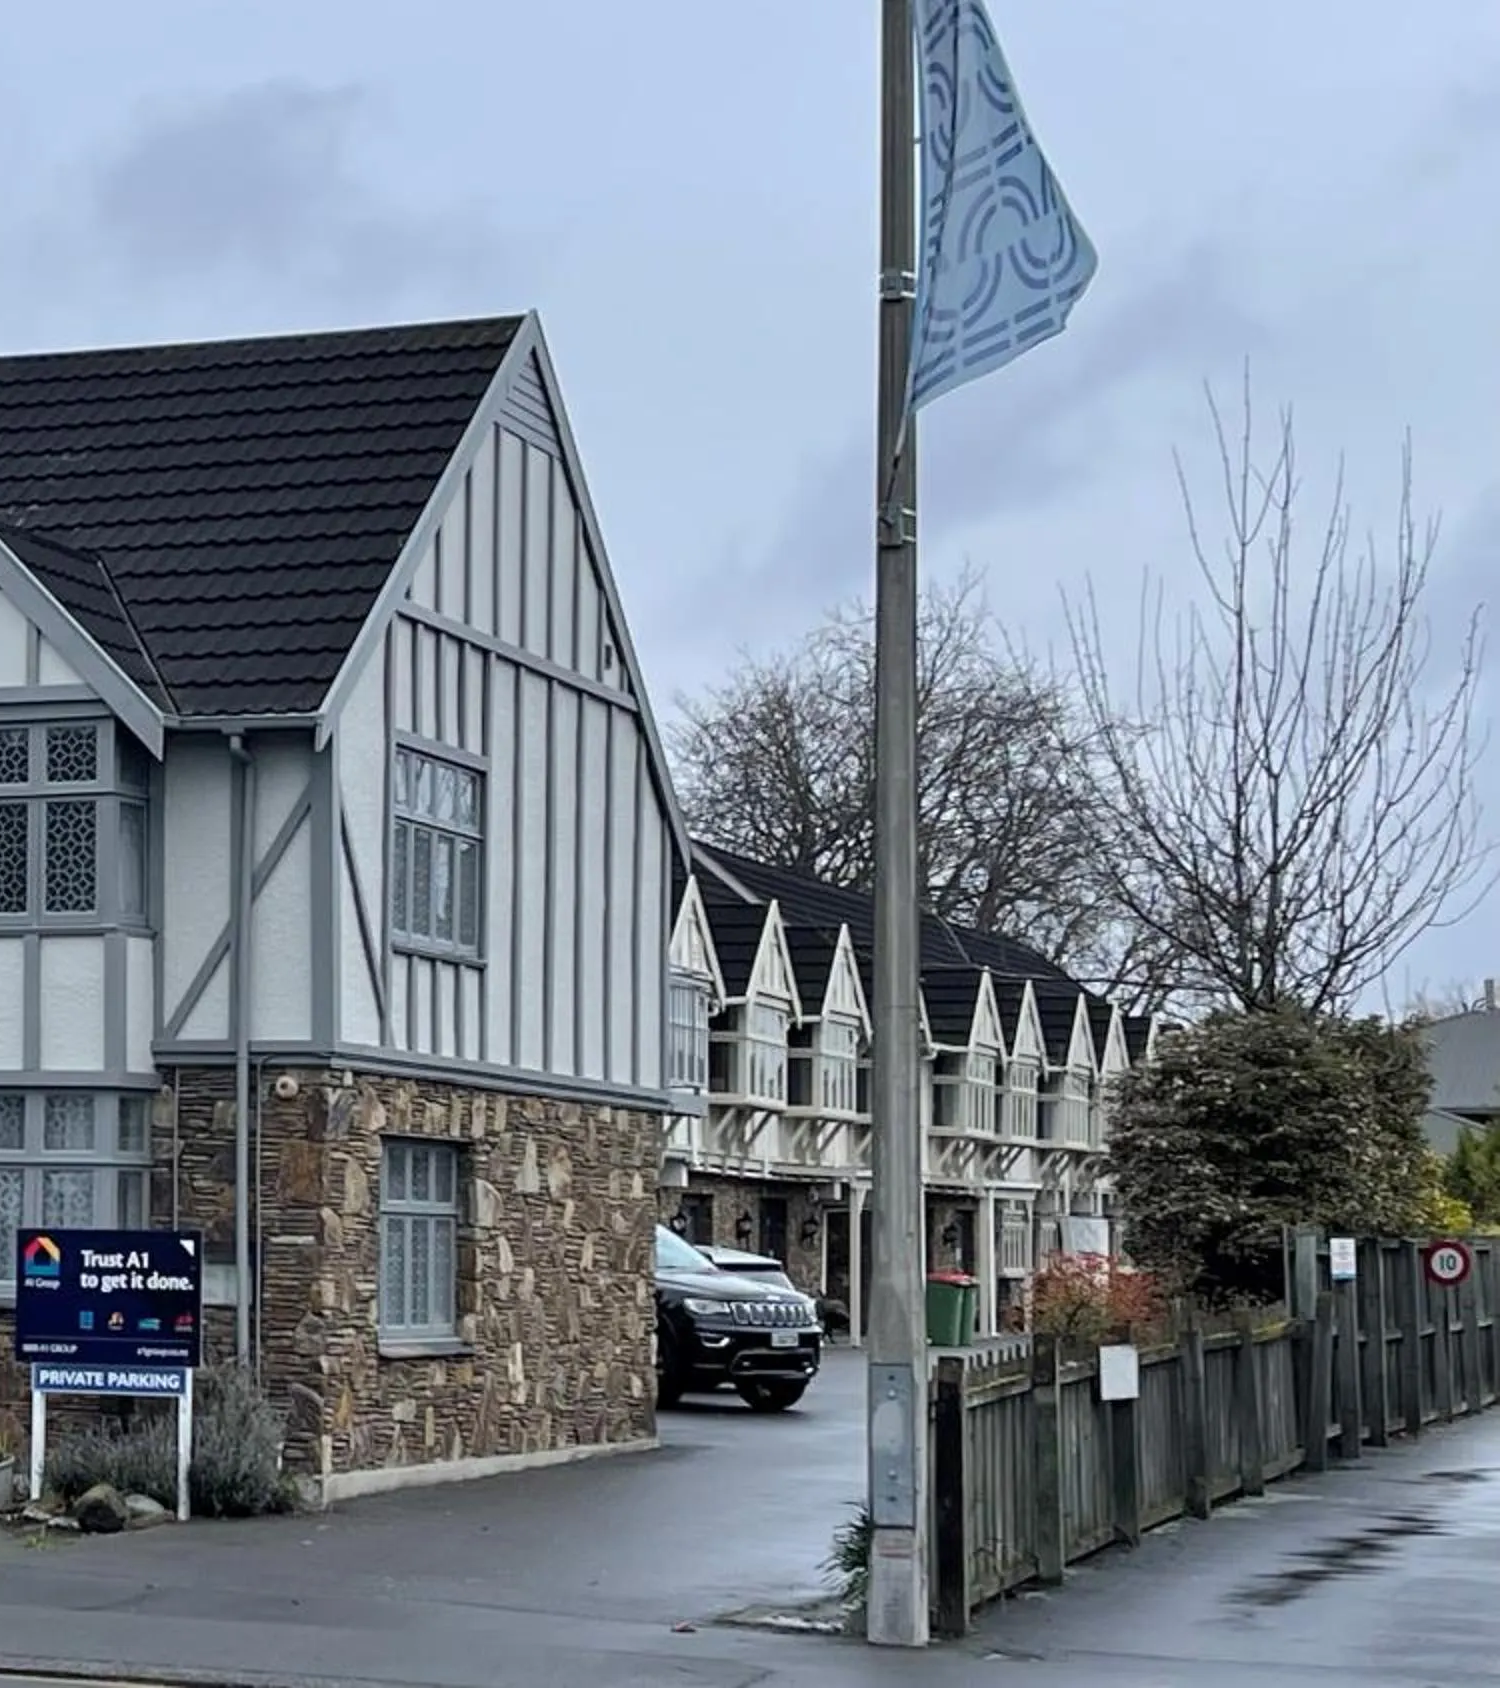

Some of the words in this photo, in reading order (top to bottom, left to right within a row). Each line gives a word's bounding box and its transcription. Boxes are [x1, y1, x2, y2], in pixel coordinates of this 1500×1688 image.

[81, 1250, 123, 1268] Trust
[126, 1252, 149, 1268] A1
[1439, 1254, 1457, 1271] 10
[80, 1274, 98, 1288] to
[101, 1274, 128, 1292] get
[131, 1272, 144, 1289] it
[147, 1271, 194, 1290] done.
[39, 1370, 104, 1387] PRIVATE
[108, 1371, 180, 1389] PARKING
